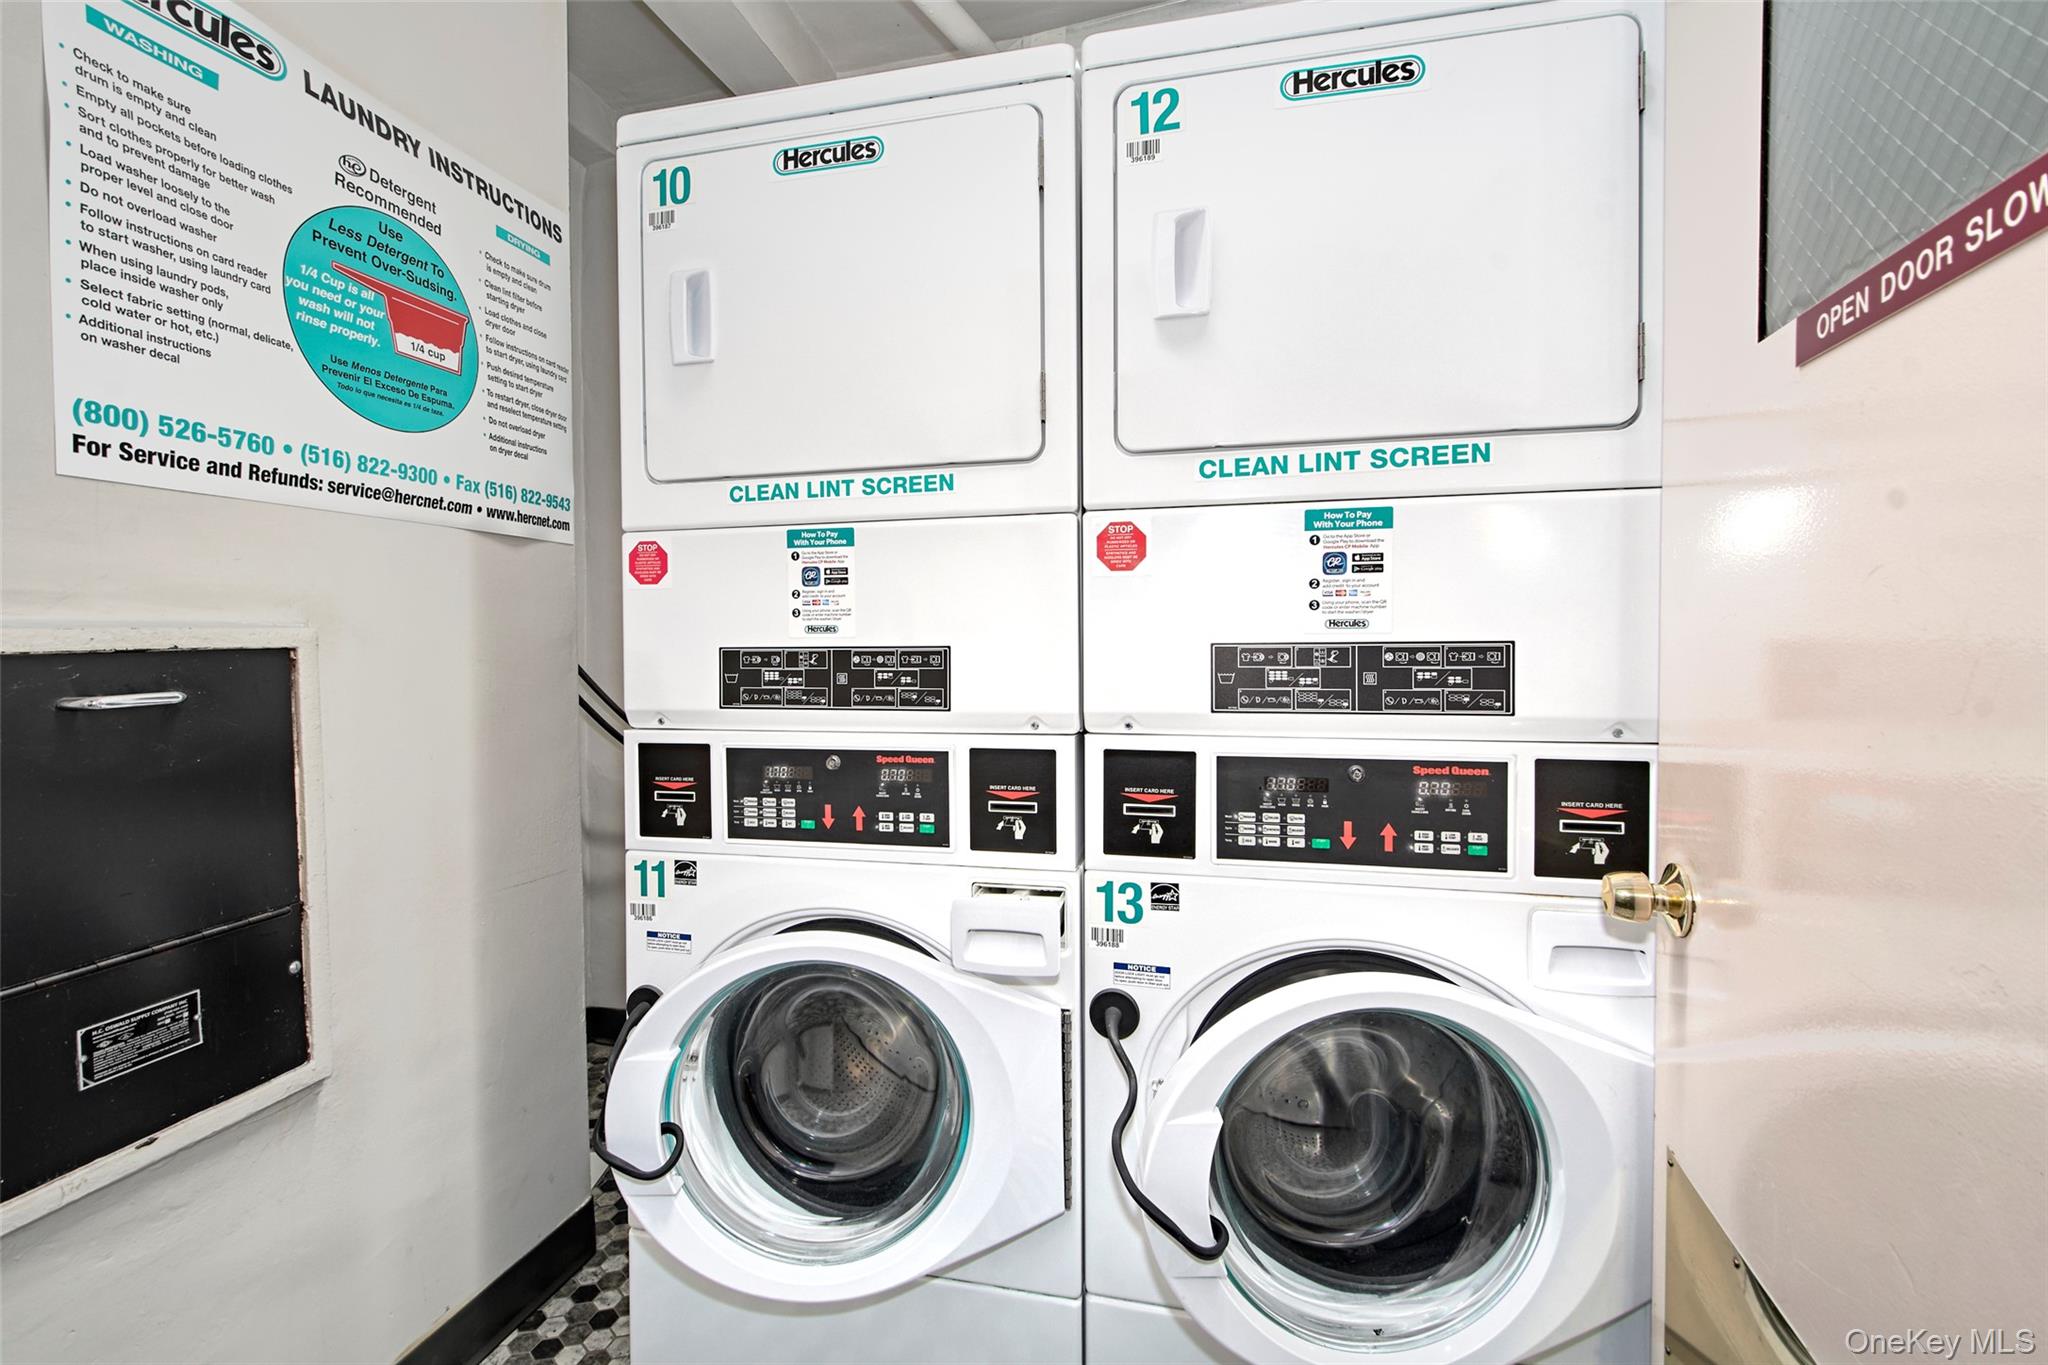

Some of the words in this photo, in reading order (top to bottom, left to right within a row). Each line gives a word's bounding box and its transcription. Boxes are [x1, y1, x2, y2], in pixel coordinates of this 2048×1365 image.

[103, 18, 203, 79] WASHING
[133, 0, 274, 71] cules
[73, 48, 113, 76] Check
[116, 70, 129, 83] to
[133, 80, 164, 101] make
[167, 97, 191, 114] sure
[1293, 59, 1415, 97] Hercules
[75, 66, 109, 88] drum
[112, 82, 122, 95] is
[126, 92, 162, 116] empty
[165, 111, 185, 126] and
[188, 123, 216, 141] clean
[1131, 87, 1181, 134] 12
[76, 84, 116, 113] Empty
[120, 108, 134, 120] all
[137, 116, 181, 143] pockets
[184, 137, 217, 160] before
[220, 154, 256, 180] loading
[258, 174, 292, 194] clothes
[303, 69, 421, 158] LAUNDRY
[428, 147, 563, 244] INSTRUCTIONS
[783, 140, 876, 170] Hercules
[335, 172, 442, 236] Recommended
[370, 168, 437, 214] Detergent
[653, 166, 690, 207] 10
[80, 181, 98, 197] Do
[103, 192, 123, 206] not
[127, 202, 176, 226] overload
[179, 222, 218, 242] washer
[379, 221, 403, 242] Use
[312, 229, 367, 263] Prevent
[372, 255, 457, 302] Over-Sudsing.
[328, 218, 362, 241] Less
[367, 235, 428, 271] Detergent
[430, 263, 444, 278] To
[284, 276, 308, 290] you
[312, 287, 341, 302] need
[344, 299, 356, 308] or
[359, 302, 386, 320] your
[301, 265, 317, 278] 1/4
[321, 273, 345, 290] Cup
[348, 283, 358, 294] is
[361, 289, 375, 300] all
[1816, 286, 1869, 339] OPEN
[1881, 235, 1954, 303] DOOR
[296, 312, 326, 328] rinse
[330, 324, 379, 346] properly.
[299, 297, 330, 314] wash
[334, 310, 353, 322] will
[356, 318, 374, 329] not
[78, 314, 143, 339] Additional
[146, 331, 212, 357] instructions
[80, 333, 97, 343] on
[101, 337, 146, 355] washer
[149, 348, 180, 364] decal
[411, 342, 424, 353] 1/4
[428, 350, 446, 362] cup
[322, 364, 360, 382] Prevenir
[364, 376, 372, 385] El
[375, 380, 406, 395] Exceso
[408, 390, 419, 399] De
[422, 393, 455, 409] Espuma.
[330, 354, 348, 367] Use
[351, 361, 381, 376] Menos
[384, 371, 428, 391] Detergente
[430, 385, 447, 396] Para
[72, 398, 150, 437] (800)
[158, 415, 275, 456] 526-5760
[301, 442, 351, 473] (516)
[357, 454, 438, 487] 822-9300
[456, 473, 481, 494] Fax
[485, 479, 517, 505] (516)
[520, 487, 571, 513] 822-9543
[1199, 453, 1289, 480] CLEAN
[1300, 450, 1361, 475] LINT
[1370, 442, 1491, 470] SCREEN
[72, 433, 112, 458] For
[118, 441, 200, 472] Service
[206, 456, 242, 479] and
[248, 464, 323, 492] Refunds:
[327, 478, 472, 516] service@hercnet.com
[487, 507, 571, 532] www.hercnet.com
[729, 481, 799, 503] CLEAN
[807, 479, 854, 500] LINT
[861, 473, 954, 496] SCREEN
[1108, 525, 1133, 533] STOP
[1313, 520, 1333, 528] With
[1356, 511, 1372, 519] Pay
[808, 625, 836, 633] Hercules
[1329, 619, 1366, 628] Hercules
[876, 755, 904, 764] Speed
[905, 755, 935, 764] Queen
[1412, 766, 1449, 776] Speed
[1451, 767, 1489, 776] Queen
[634, 860, 665, 898] 11
[1096, 881, 1144, 924] 13
[657, 932, 680, 940] NOTICE
[1127, 963, 1156, 973] NOTICE
